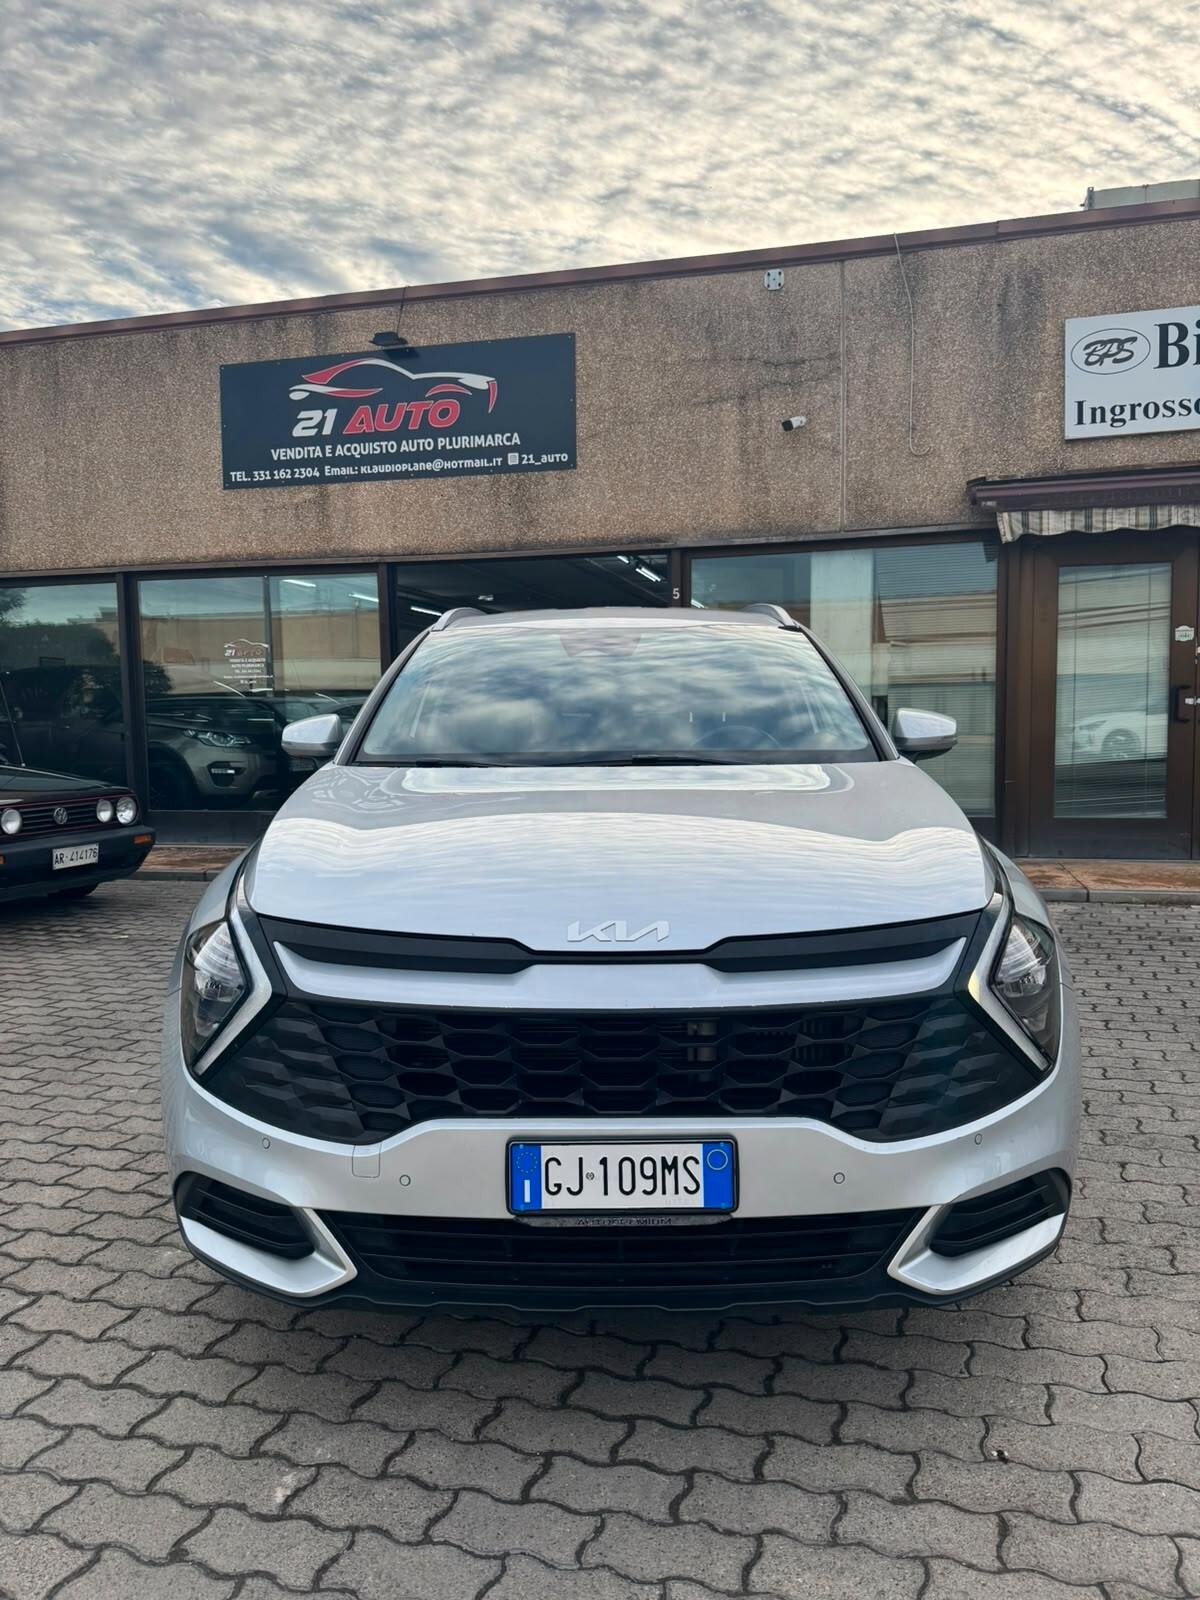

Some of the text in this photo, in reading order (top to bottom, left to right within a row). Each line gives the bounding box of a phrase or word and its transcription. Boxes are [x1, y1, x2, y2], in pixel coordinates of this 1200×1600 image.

[292, 399, 461, 437] 21 AUTO
[271, 432, 521, 461] VENDITA E ACQUISTO AUTO PLURIMARCA
[230, 471, 251, 482] TEL.
[253, 470, 271, 481] 331
[273, 468, 292, 480] 162
[294, 467, 320, 479] 2304
[672, 587, 680, 600] 5
